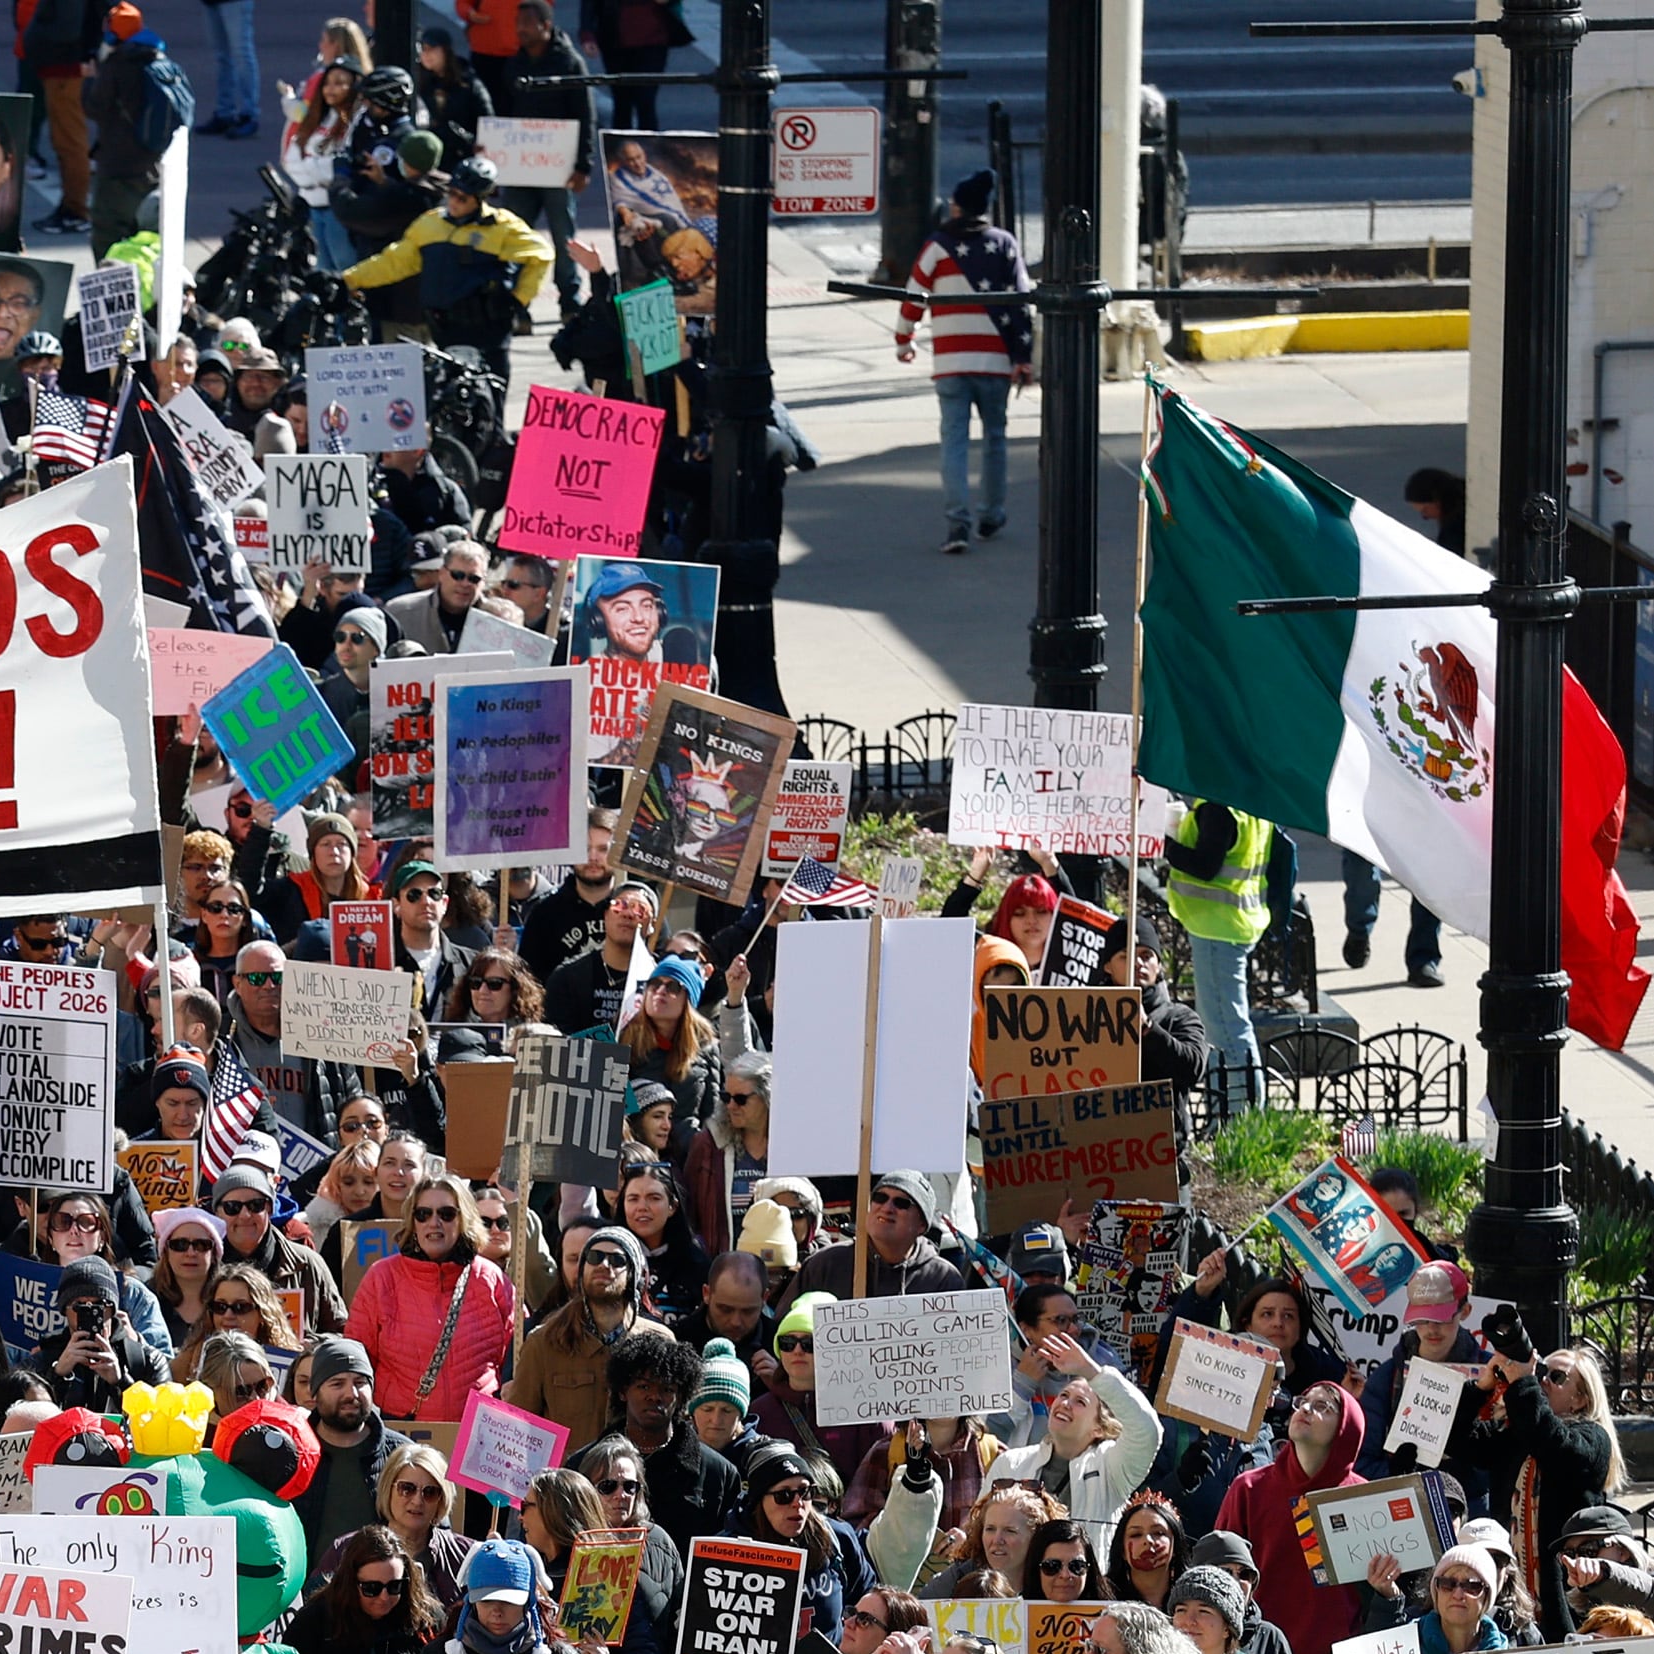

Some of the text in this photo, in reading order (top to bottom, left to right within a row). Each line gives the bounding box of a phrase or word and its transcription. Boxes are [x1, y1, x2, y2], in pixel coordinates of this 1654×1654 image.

[779, 158, 853, 169] NO STOPPING
[779, 170, 853, 182] NO STANDING
[779, 198, 867, 211] TOW ZONE
[524, 392, 662, 450] DEMOCRACY
[557, 461, 610, 490] NOT
[276, 465, 358, 509] MAGA
[306, 513, 323, 531] IS
[700, 1544, 792, 1564] RefuseFascism.org
[703, 1566, 785, 1595] STOP
[709, 1592, 774, 1616] WAR
[717, 1616, 759, 1635] ON
